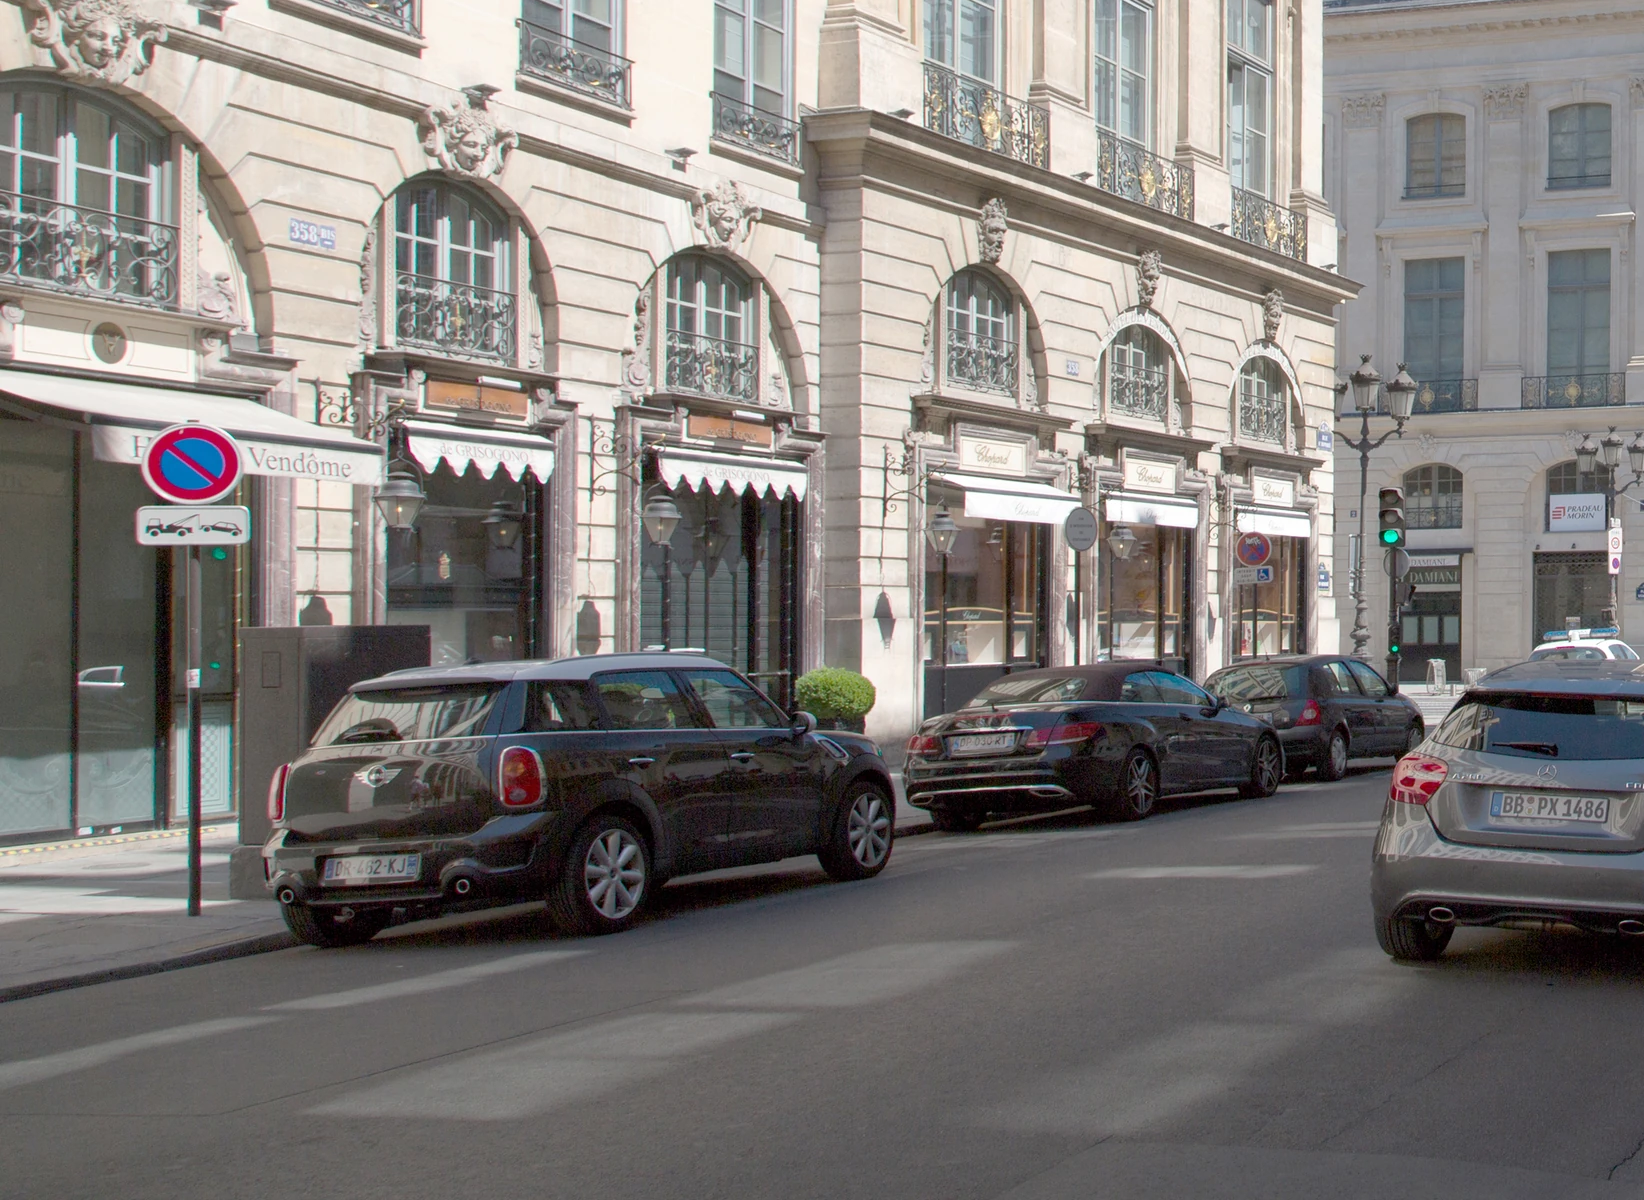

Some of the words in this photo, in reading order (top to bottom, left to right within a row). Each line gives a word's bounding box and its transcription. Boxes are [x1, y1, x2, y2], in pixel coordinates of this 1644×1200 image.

[291, 221, 318, 243] 358
[1067, 362, 1079, 374] 358
[248, 447, 352, 478] Vendôme
[440, 443, 452, 456] de
[455, 444, 529, 464] GRISOGONO
[975, 444, 1011, 467] Chopard
[703, 467, 713, 478] de
[715, 467, 770, 482] GRISOGONO
[1136, 465, 1164, 485] Chopard
[1262, 482, 1284, 499] Chopard
[1410, 571, 1458, 582] DAMIANI
[962, 611, 981, 620] Chopard
[1502, 795, 1525, 814] BB
[1537, 796, 1558, 816] PX
[1562, 798, 1605, 819] 1486
[335, 857, 407, 877] DR-462-KJ
